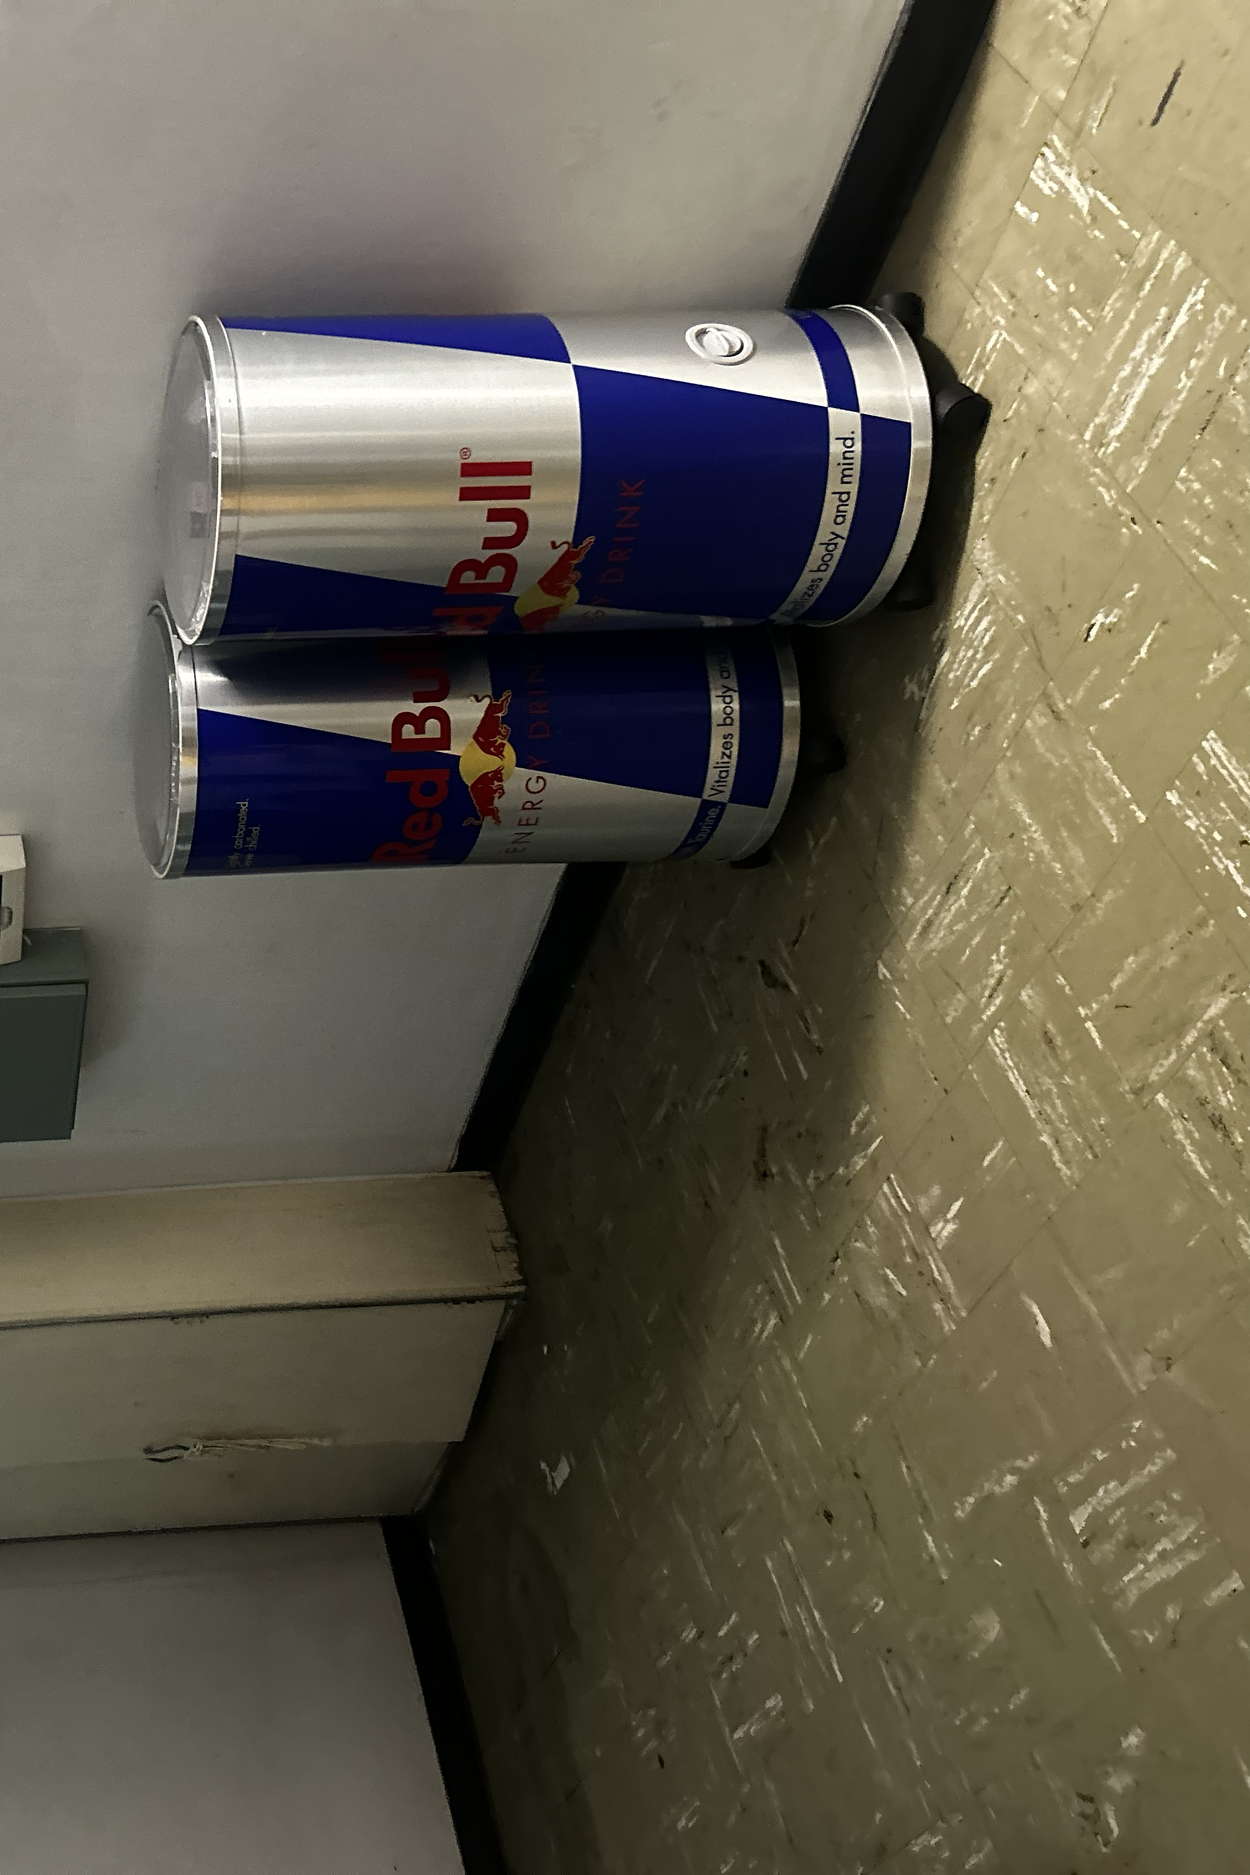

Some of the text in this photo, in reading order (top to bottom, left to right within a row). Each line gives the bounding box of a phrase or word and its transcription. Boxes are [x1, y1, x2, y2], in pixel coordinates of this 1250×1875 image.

[835, 430, 855, 484] mind.
[598, 478, 646, 584] DRINK
[832, 491, 851, 526] and
[808, 531, 845, 573] body
[716, 684, 737, 727] body
[706, 732, 734, 798] Vitalizes
[231, 798, 250, 850] carbonated.
[370, 768, 450, 863] Red
[504, 755, 550, 854] ENERGY
